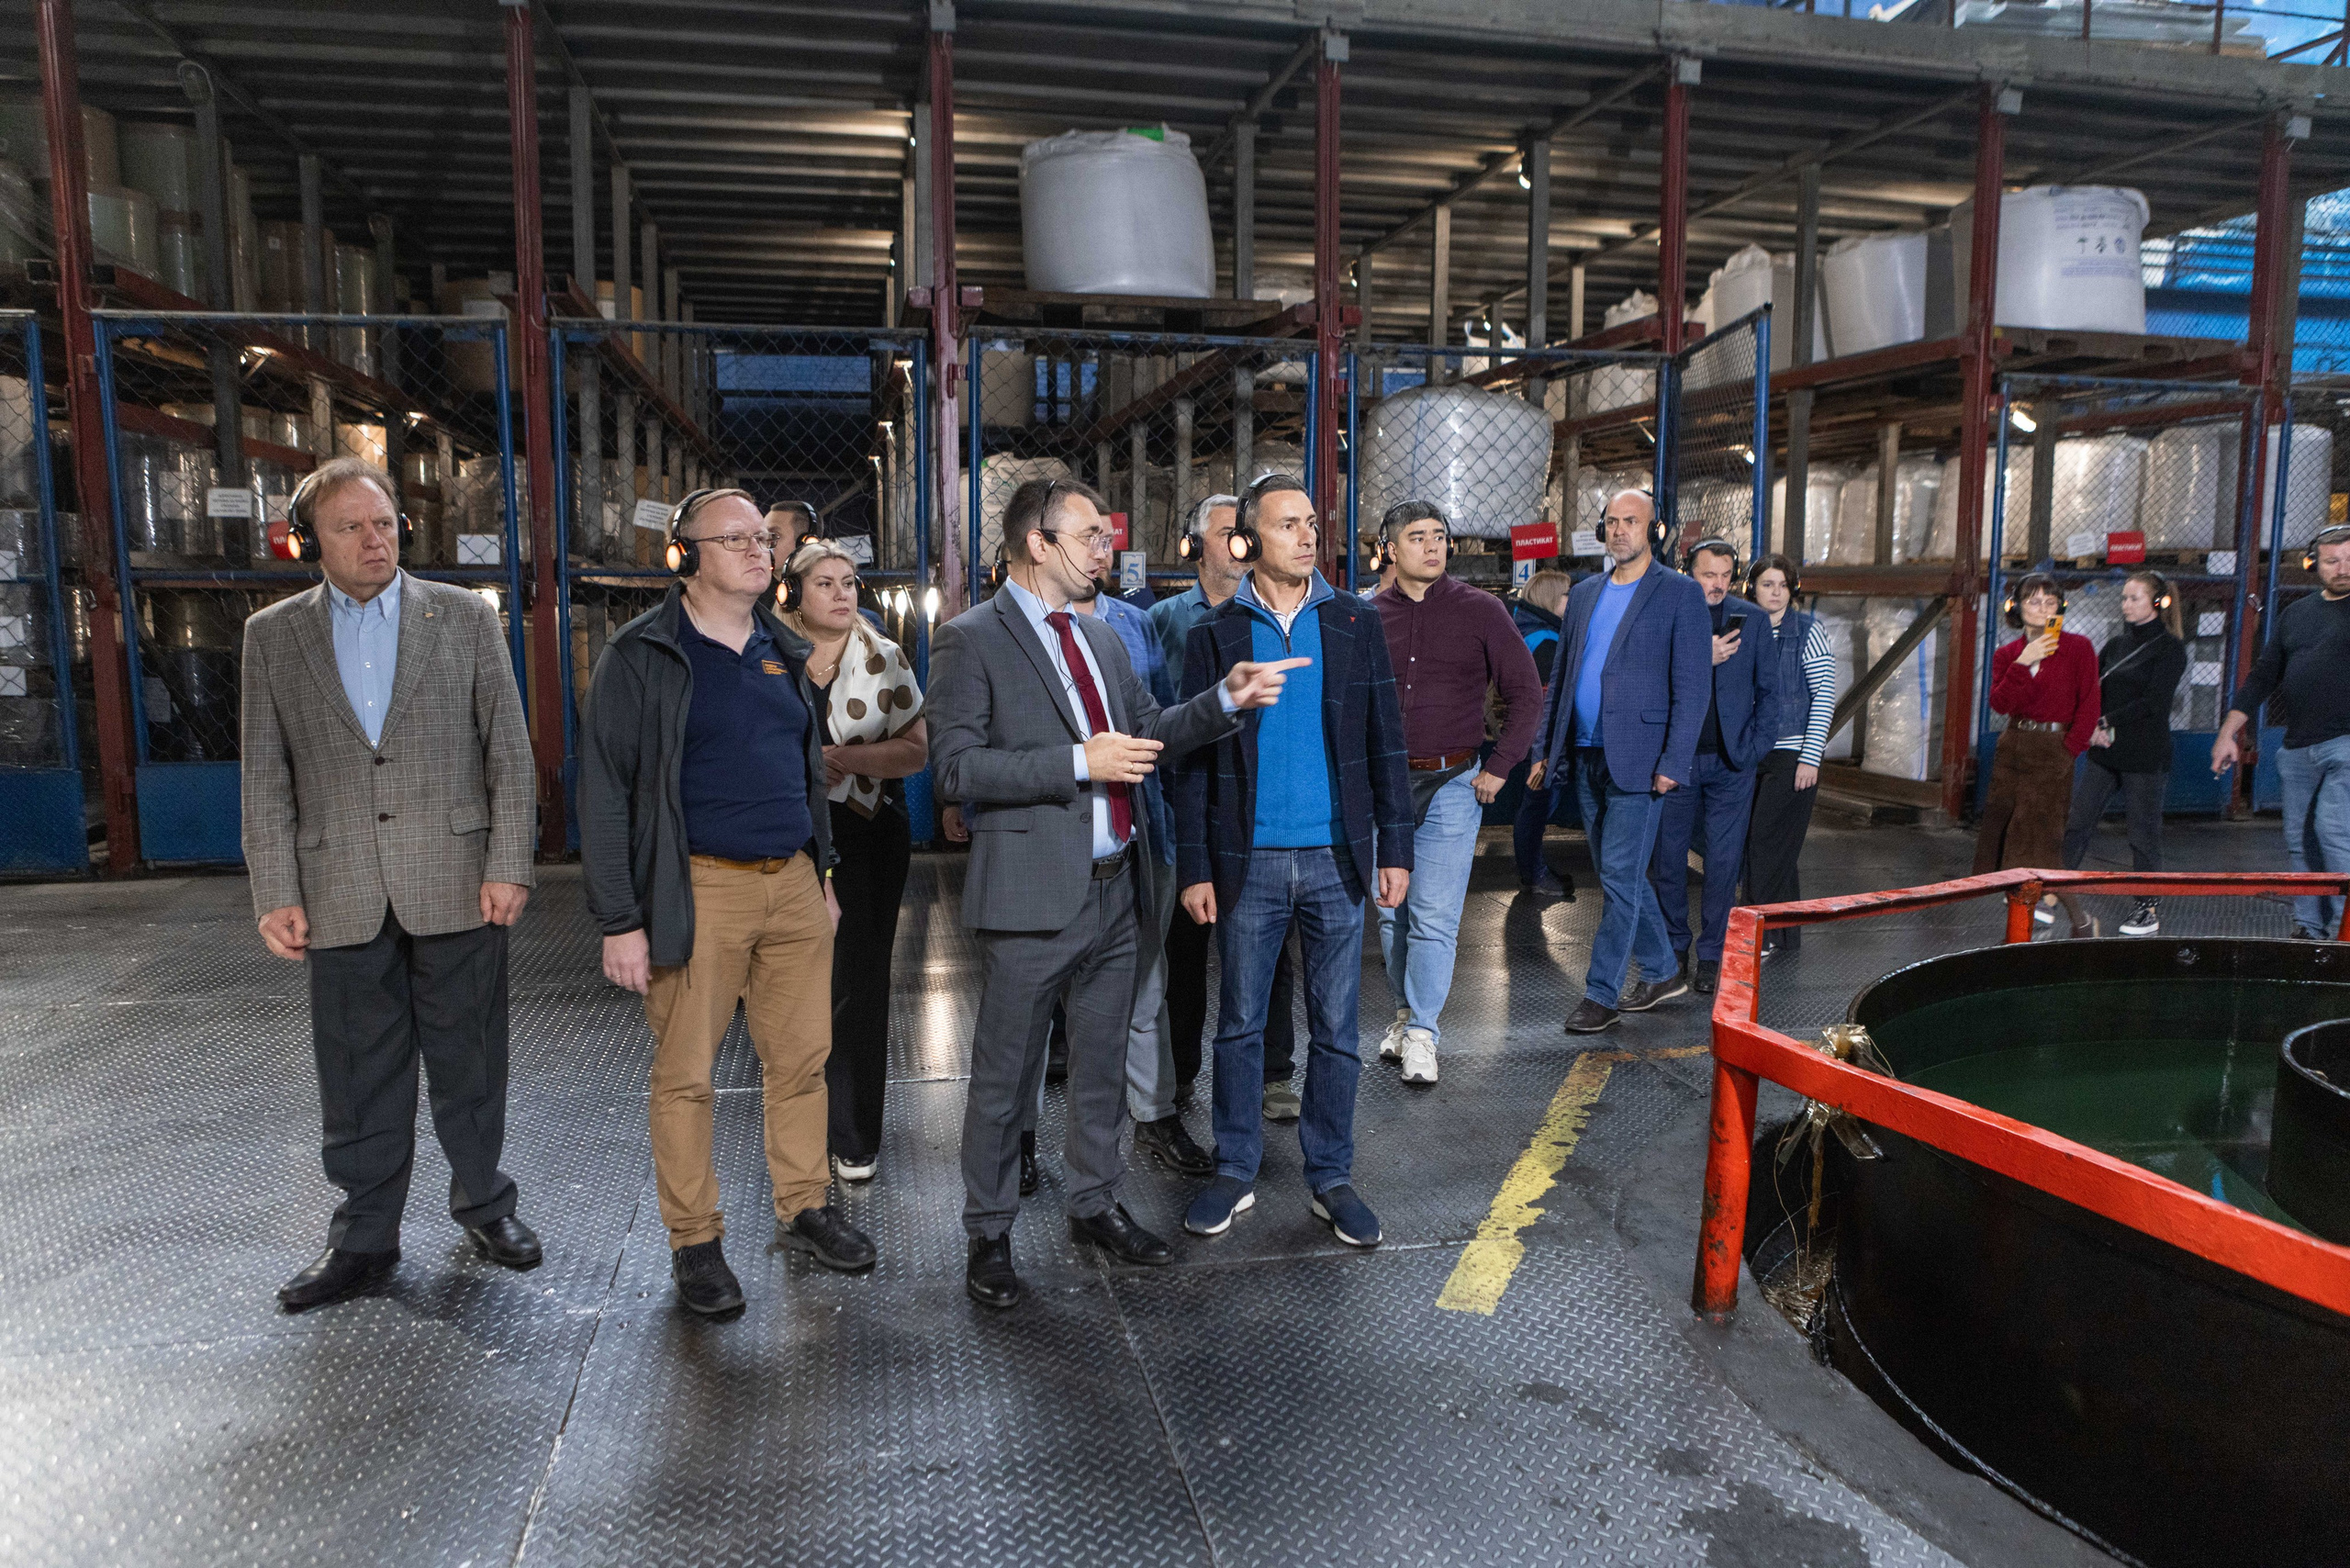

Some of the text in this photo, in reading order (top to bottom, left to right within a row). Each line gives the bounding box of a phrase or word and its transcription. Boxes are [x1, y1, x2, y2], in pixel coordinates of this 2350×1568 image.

[1516, 536, 1553, 547] ПЛАСТИКАТ
[1126, 563, 1139, 583] 5
[1518, 563, 1529, 581] 4
